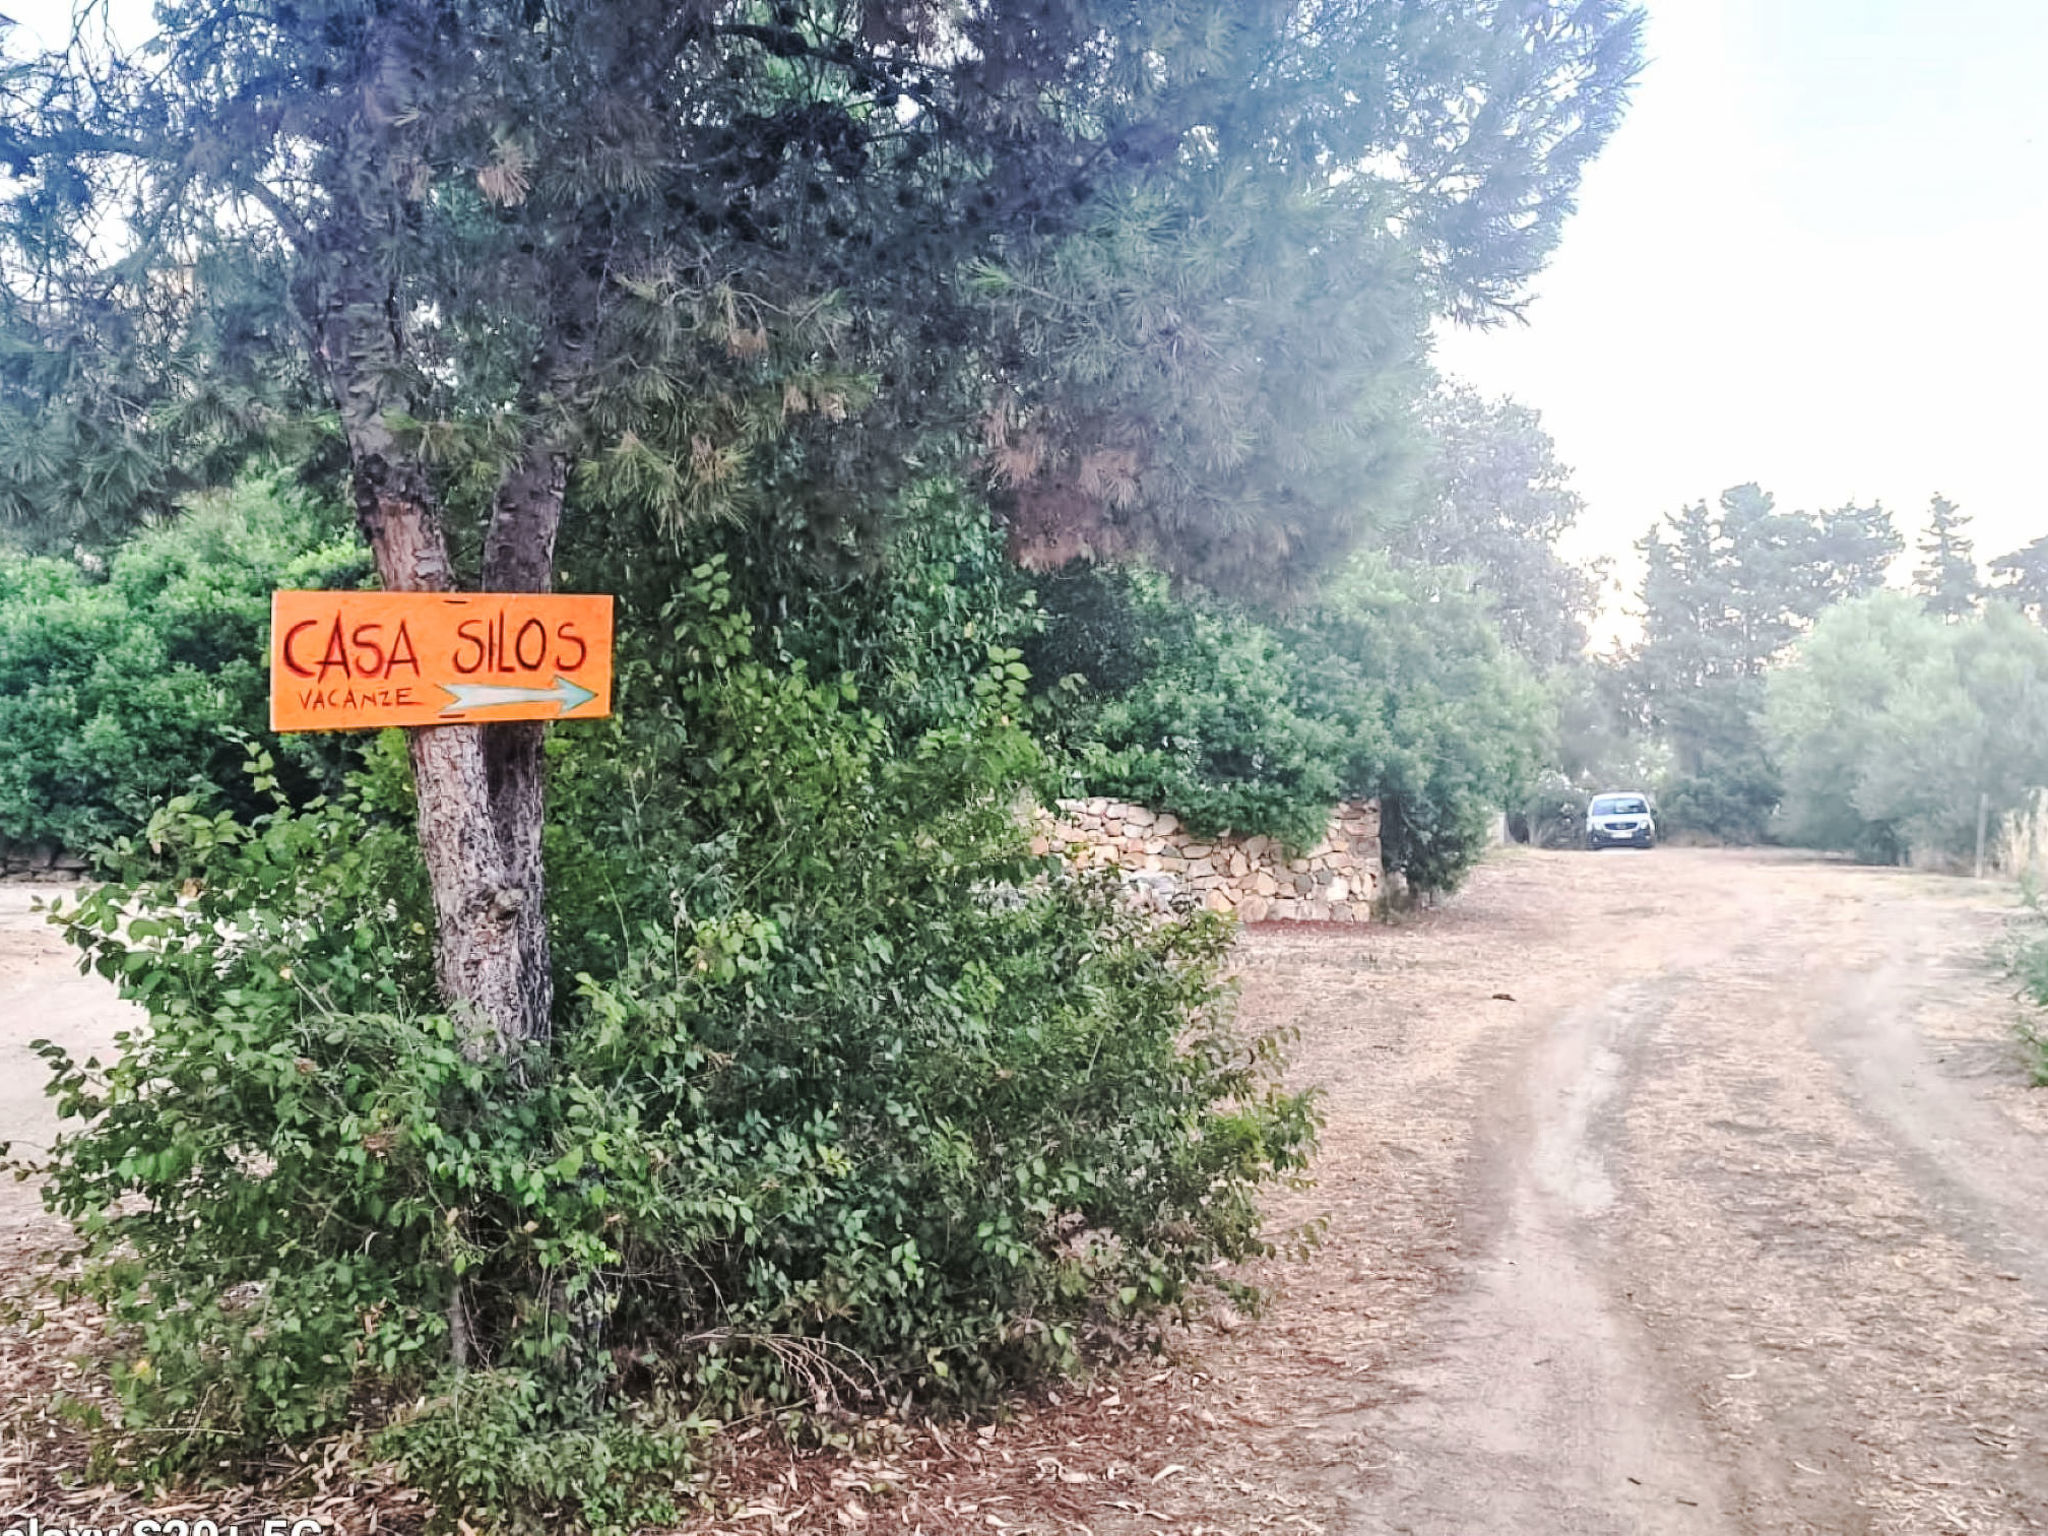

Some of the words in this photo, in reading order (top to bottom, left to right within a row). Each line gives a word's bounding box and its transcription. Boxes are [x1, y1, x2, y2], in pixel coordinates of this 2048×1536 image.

[283, 609, 420, 683] CASA
[453, 608, 587, 674] SILOS
[299, 687, 424, 711] VACANZE
